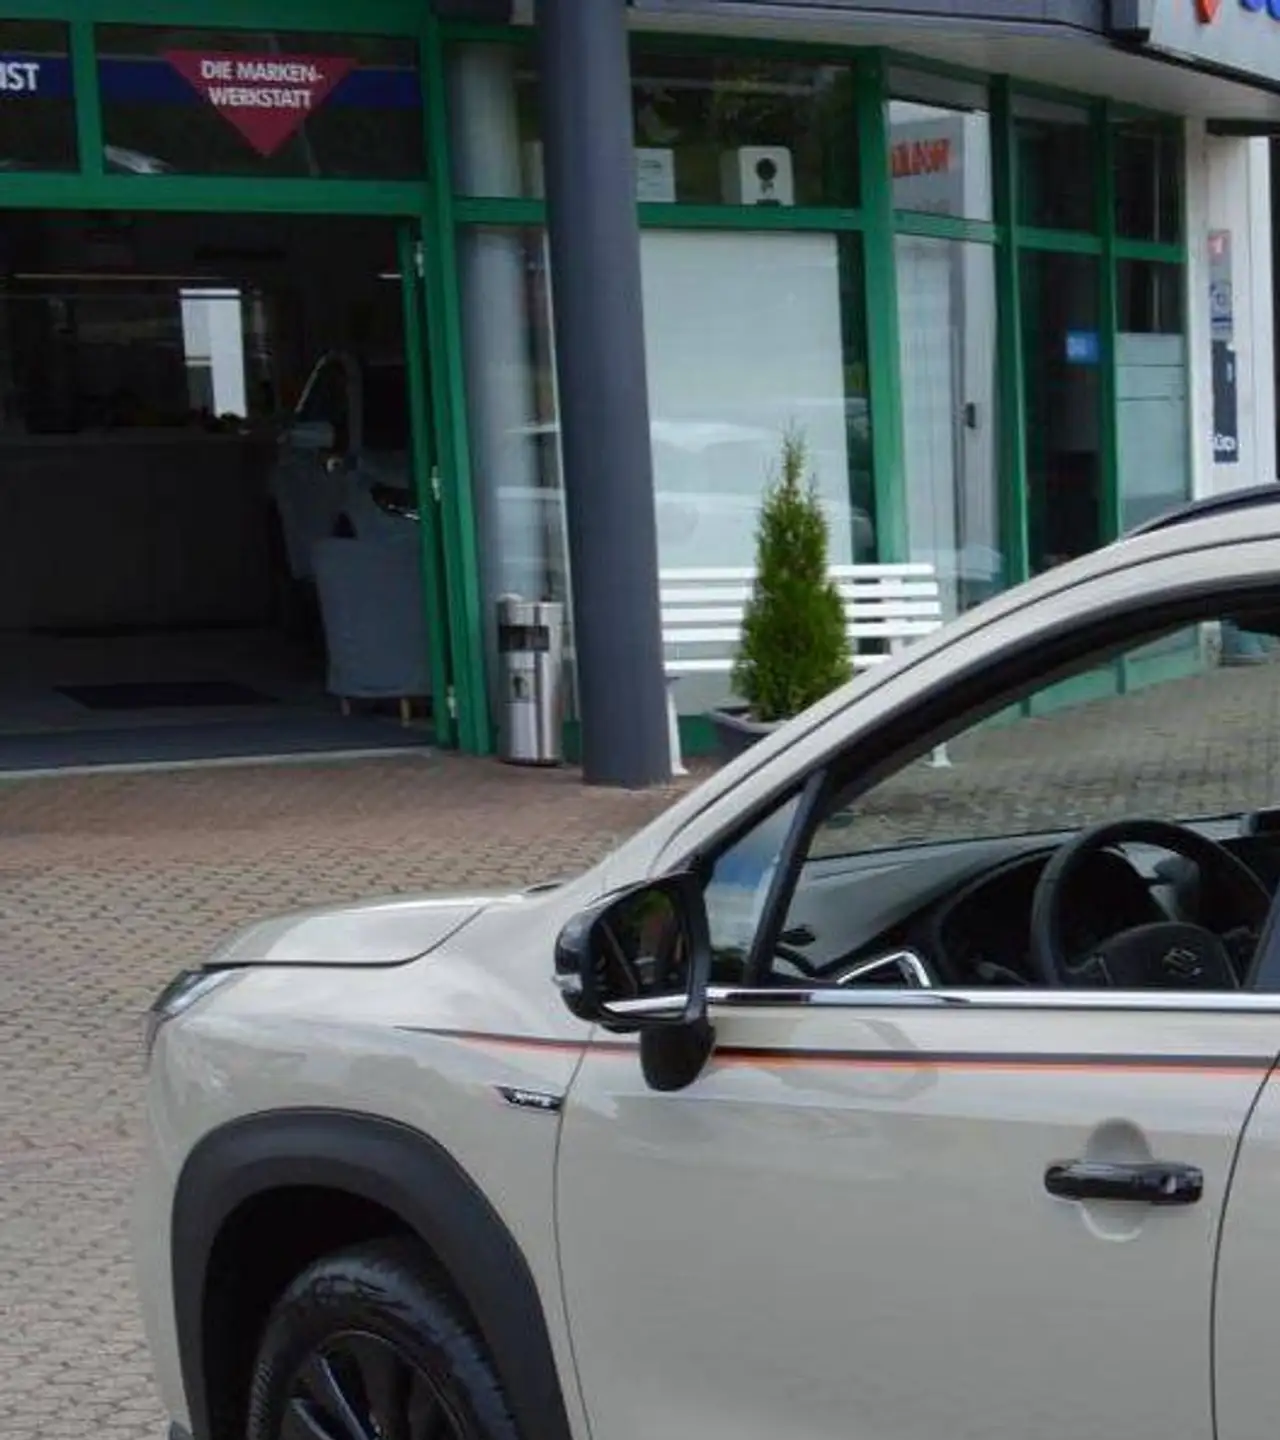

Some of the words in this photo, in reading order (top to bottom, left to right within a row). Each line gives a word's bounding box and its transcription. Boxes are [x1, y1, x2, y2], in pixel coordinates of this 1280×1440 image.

[201, 60, 231, 80] DIE
[237, 62, 325, 83] MARKEN-
[208, 86, 313, 109] WERKSTATT
